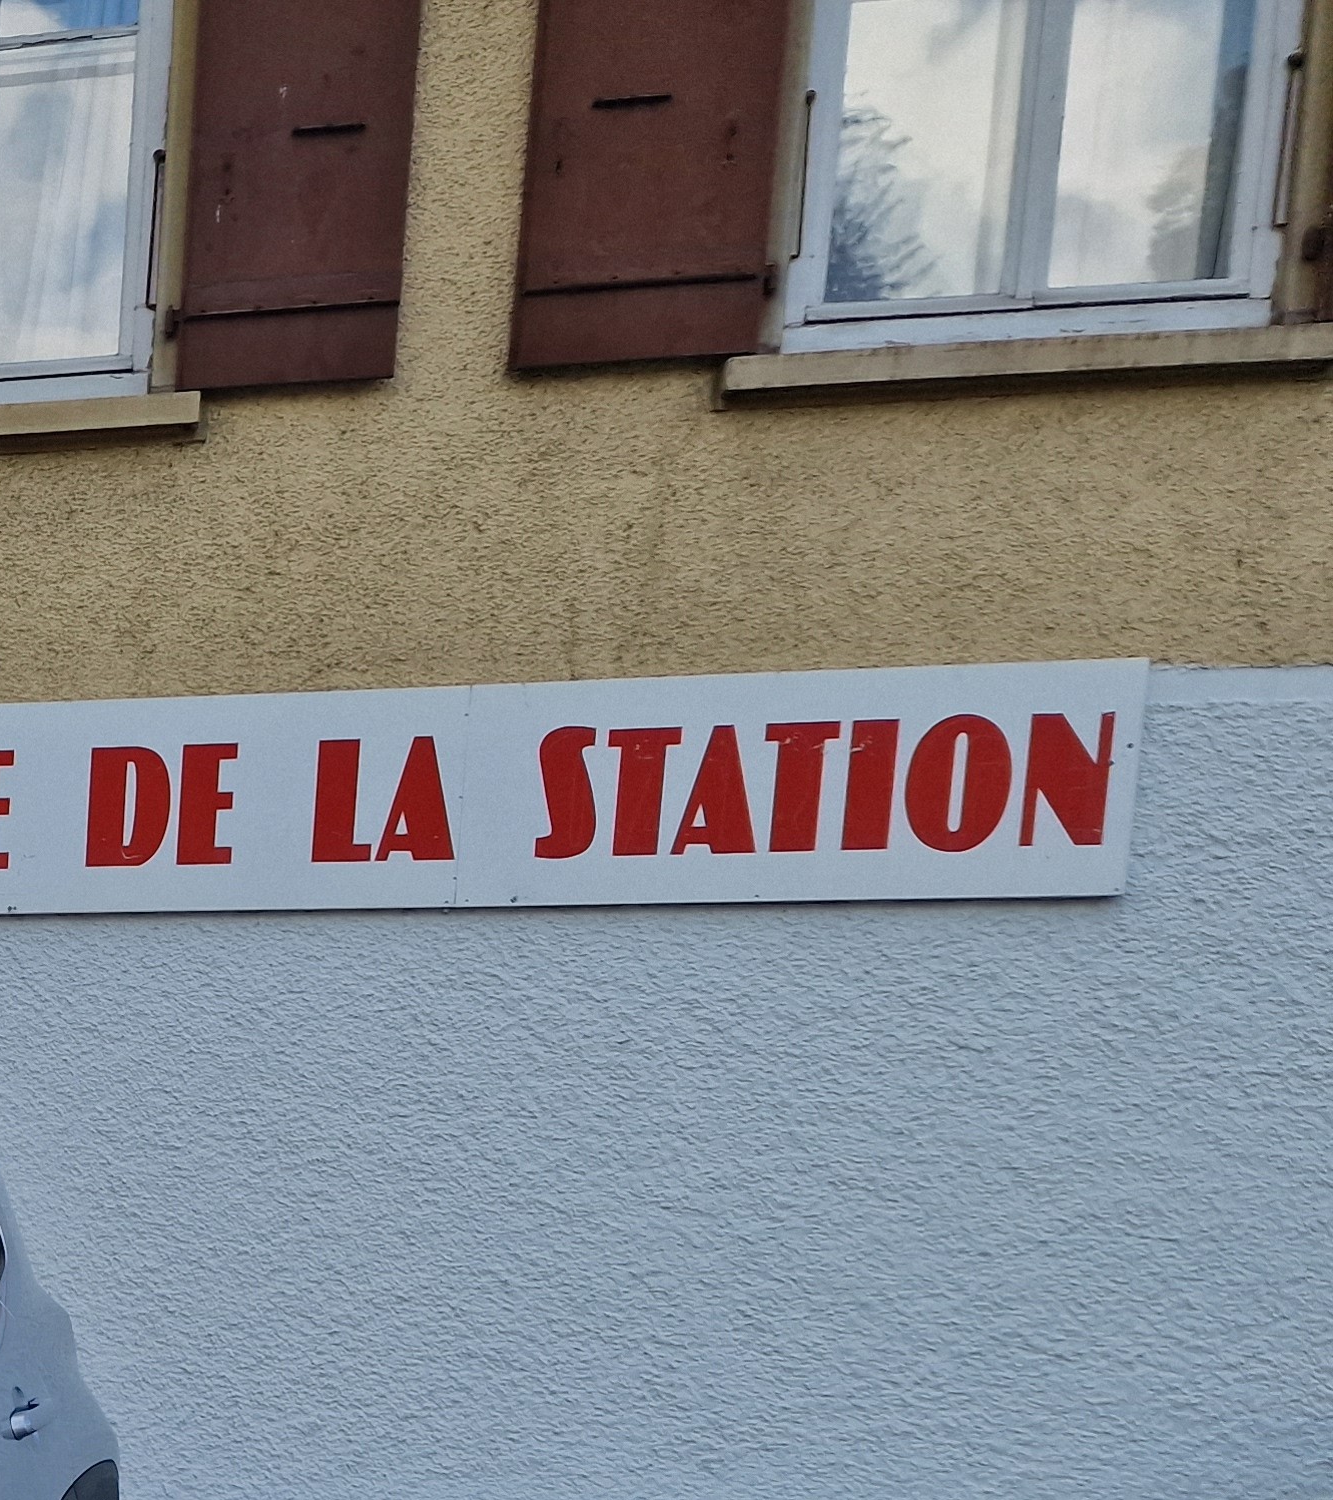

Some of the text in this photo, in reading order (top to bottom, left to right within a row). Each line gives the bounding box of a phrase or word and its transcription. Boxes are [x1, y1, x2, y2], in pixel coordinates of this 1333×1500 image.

[85, 742, 238, 868] DE
[310, 735, 455, 863] LA
[534, 710, 1116, 860] STATION
